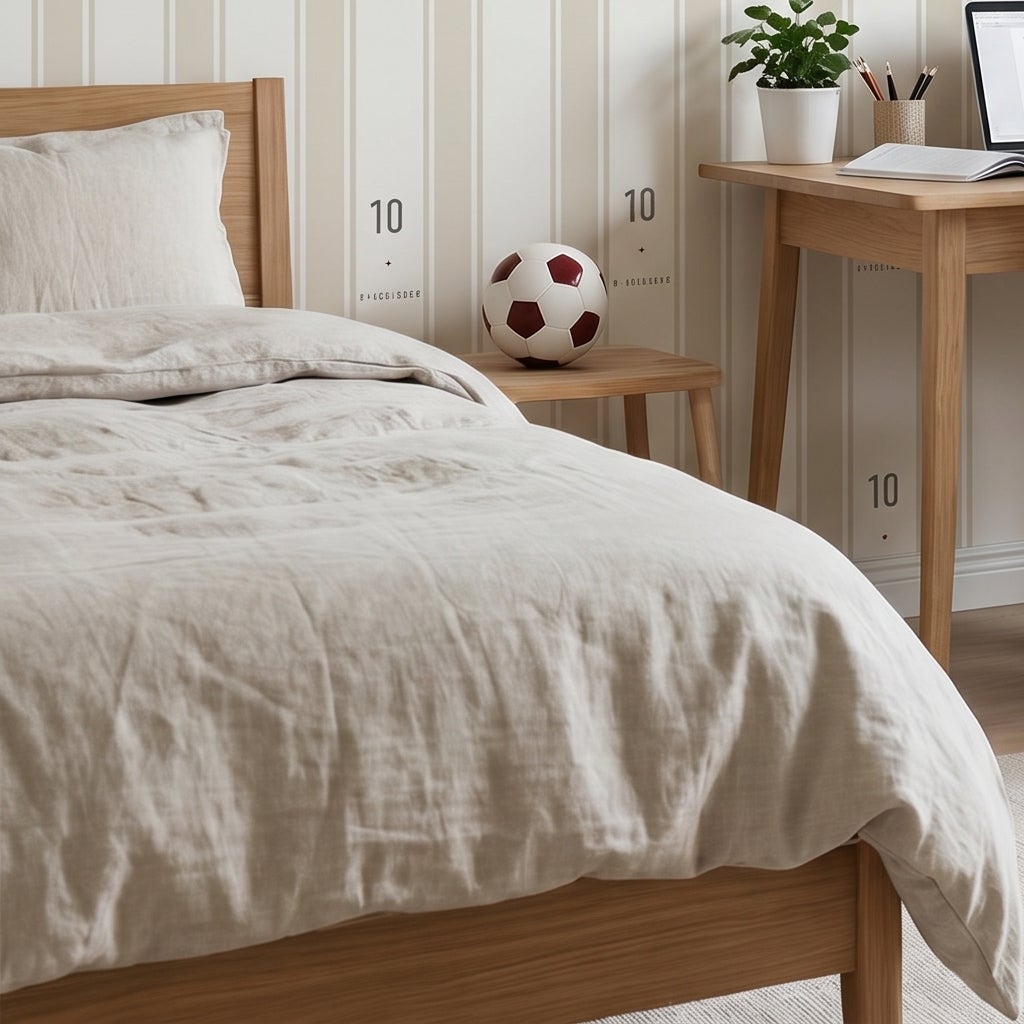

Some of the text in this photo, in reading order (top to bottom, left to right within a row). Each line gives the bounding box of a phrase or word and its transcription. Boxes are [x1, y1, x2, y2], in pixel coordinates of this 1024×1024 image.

[370, 198, 403, 235] 10
[624, 187, 656, 223] 10
[867, 472, 899, 509] 10
